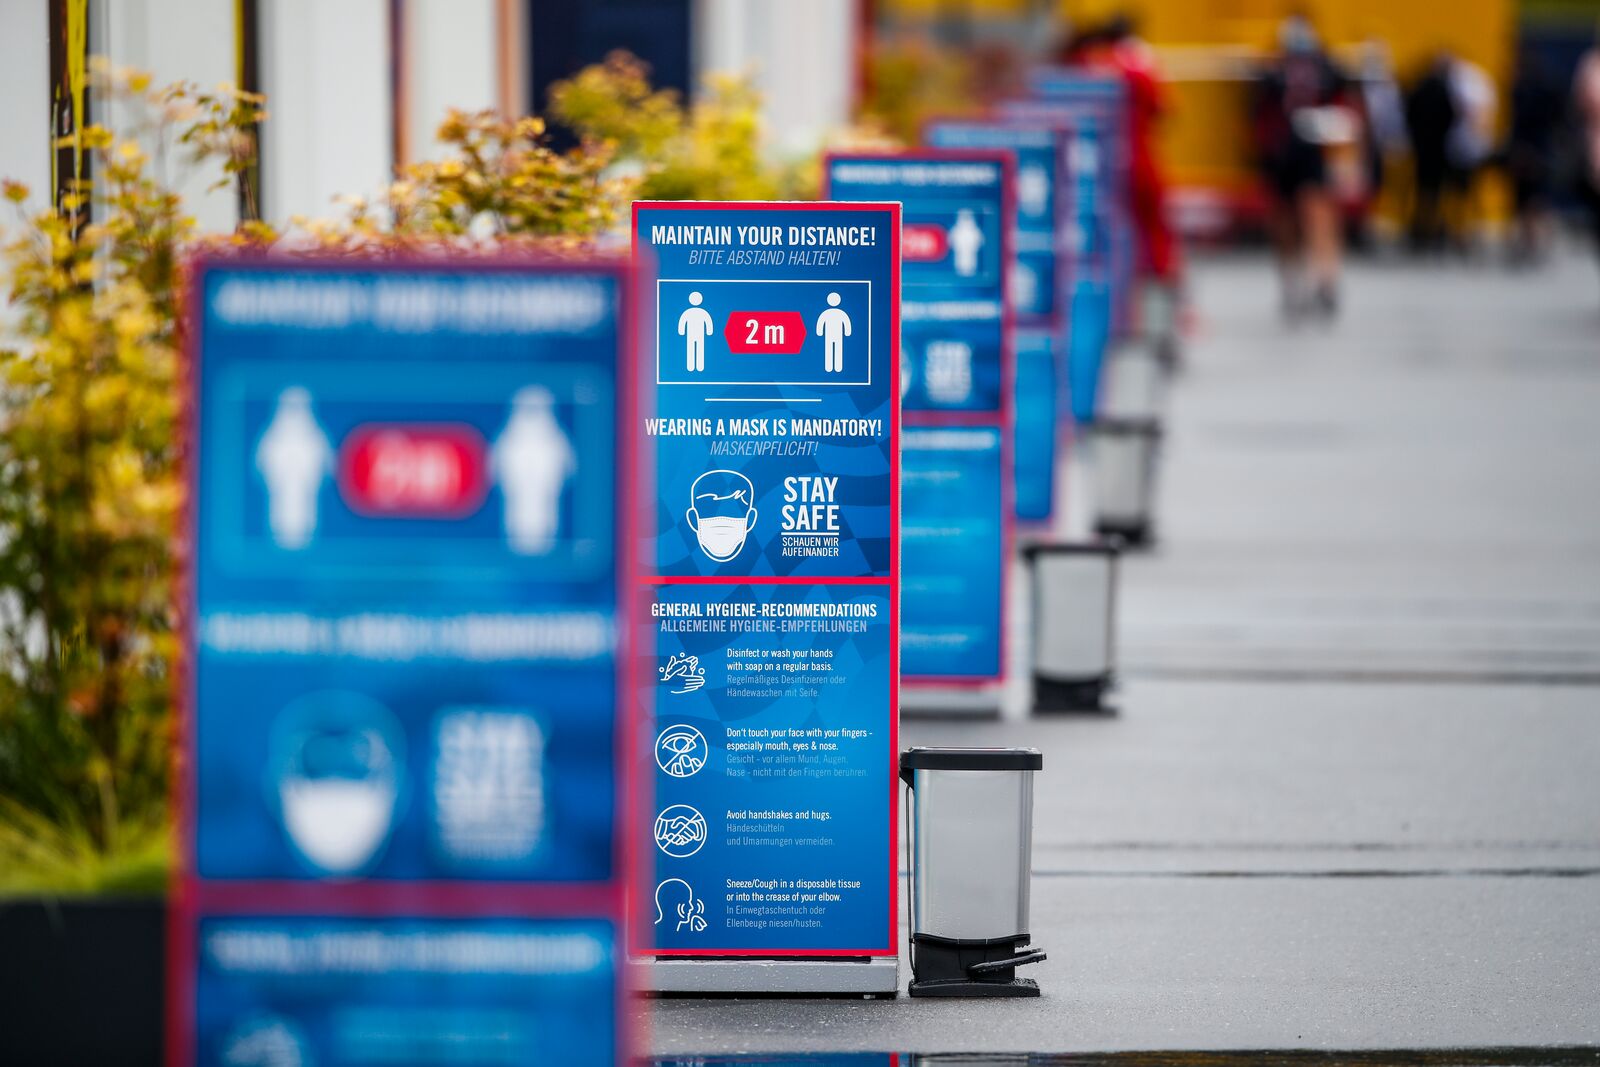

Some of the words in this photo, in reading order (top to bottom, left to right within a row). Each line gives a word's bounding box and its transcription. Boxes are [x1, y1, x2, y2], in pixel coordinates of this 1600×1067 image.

[652, 225, 732, 245] MAINTAIN
[737, 226, 783, 246] YOUR
[788, 226, 876, 246] DISTANCE!
[688, 249, 725, 265] BITTE
[726, 250, 785, 266] ABSTAND
[788, 250, 842, 266] HALTEN!
[745, 319, 759, 344] 2
[764, 324, 785, 345] m
[645, 418, 712, 436] WEARING
[716, 418, 726, 436] A
[729, 418, 769, 436] MASK
[773, 418, 787, 436] IS
[791, 418, 882, 436] MANDATORY!
[710, 440, 819, 456] MASKENPFLICHT!
[784, 476, 839, 503] STAY
[781, 504, 840, 531] SAFE
[782, 536, 821, 547] SCHAUEN
[823, 537, 839, 547] WIR
[782, 547, 839, 557] AUFEINANDER
[651, 603, 704, 617] GENERAL
[706, 603, 877, 618] HYGIENE-RECOMMENDATIONS
[660, 618, 727, 632] ALLGEMEINE
[730, 619, 867, 633] HYGIENE-EMPFEHLUNGEN
[727, 648, 760, 658] Disinfect
[761, 650, 770, 658] or
[770, 648, 791, 658] wash
[792, 650, 809, 660] your
[810, 648, 834, 658] hands
[726, 661, 743, 671] with
[744, 663, 763, 672] soap
[764, 663, 774, 671] on
[775, 663, 781, 671] a
[782, 661, 810, 673] regular
[811, 661, 834, 671] basis.
[780, 674, 828, 684] Desinfizieren
[829, 675, 846, 684] oder
[726, 687, 783, 697] Händewaschen
[784, 688, 797, 697] mit
[799, 688, 819, 698] Seife.
[748, 728, 769, 738] touch
[770, 730, 787, 739] your
[788, 727, 805, 738] face
[805, 728, 823, 738] with
[824, 730, 840, 739] your
[841, 728, 868, 739] fingers
[726, 741, 764, 752] especially
[765, 741, 791, 751] mouth,
[792, 742, 810, 752] eyes
[810, 740, 817, 751] &
[819, 743, 838, 751] nose.
[726, 810, 747, 820] Avoid
[748, 810, 794, 820] handshakes
[794, 810, 810, 820] and
[811, 810, 832, 822] hugs.
[726, 823, 785, 833] Händeschütteln
[726, 836, 741, 846] und
[742, 836, 793, 848] Umarmungen
[726, 878, 778, 890] Sneeze/Cough
[780, 878, 788, 888] in
[789, 880, 794, 888] a
[796, 878, 836, 890] disposable
[837, 879, 861, 889] tissue
[726, 894, 734, 902] or
[736, 892, 750, 902] into
[751, 892, 764, 902] the
[765, 894, 791, 902] crease
[791, 892, 800, 902] of
[800, 894, 817, 904] your
[818, 892, 842, 902] elbow.
[726, 905, 734, 914] In
[735, 904, 808, 916] Einwegtaschentuch
[809, 905, 826, 915] oder
[726, 918, 768, 930] Ellenbeuge
[768, 918, 823, 928] niesen/husten.
